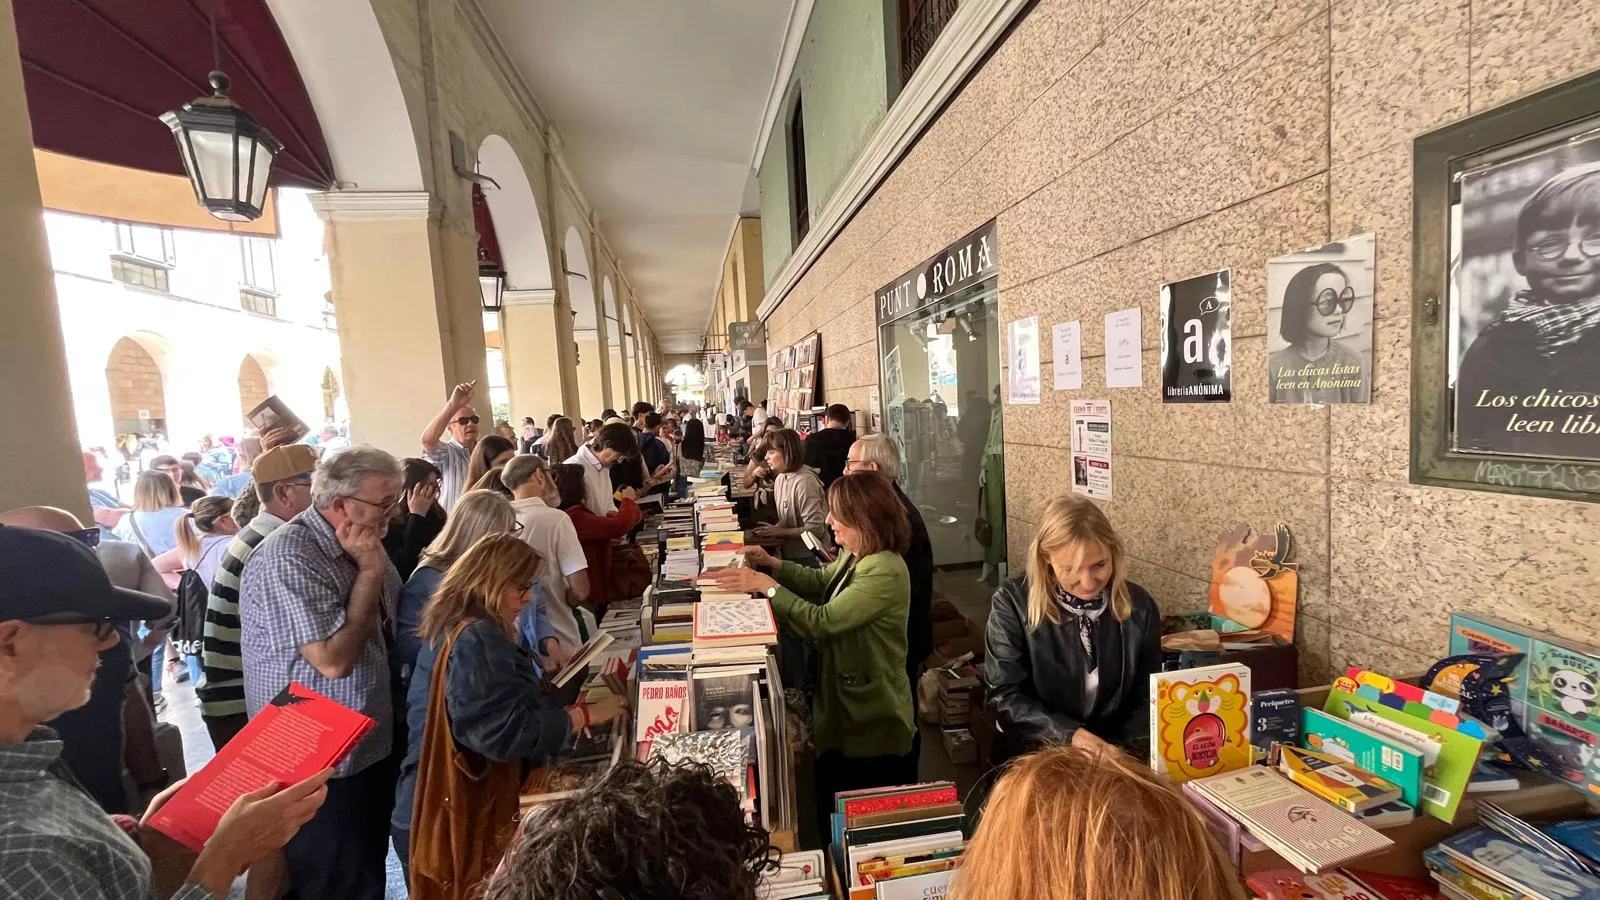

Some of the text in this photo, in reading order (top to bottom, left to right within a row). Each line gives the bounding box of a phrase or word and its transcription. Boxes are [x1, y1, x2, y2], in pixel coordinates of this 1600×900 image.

[880, 235, 992, 319] PUNT ROMA
[1183, 318, 1204, 364] a
[1277, 362, 1360, 378] Las chicas listas
[1276, 376, 1362, 390] leen en Anónima
[1474, 388, 1600, 408] Los chicos
[1505, 413, 1555, 432] leen
[642, 684, 687, 700] PEDRO BAÑOS
[1260, 699, 1295, 710] Periquetes
[1257, 717, 1267, 732] 3
